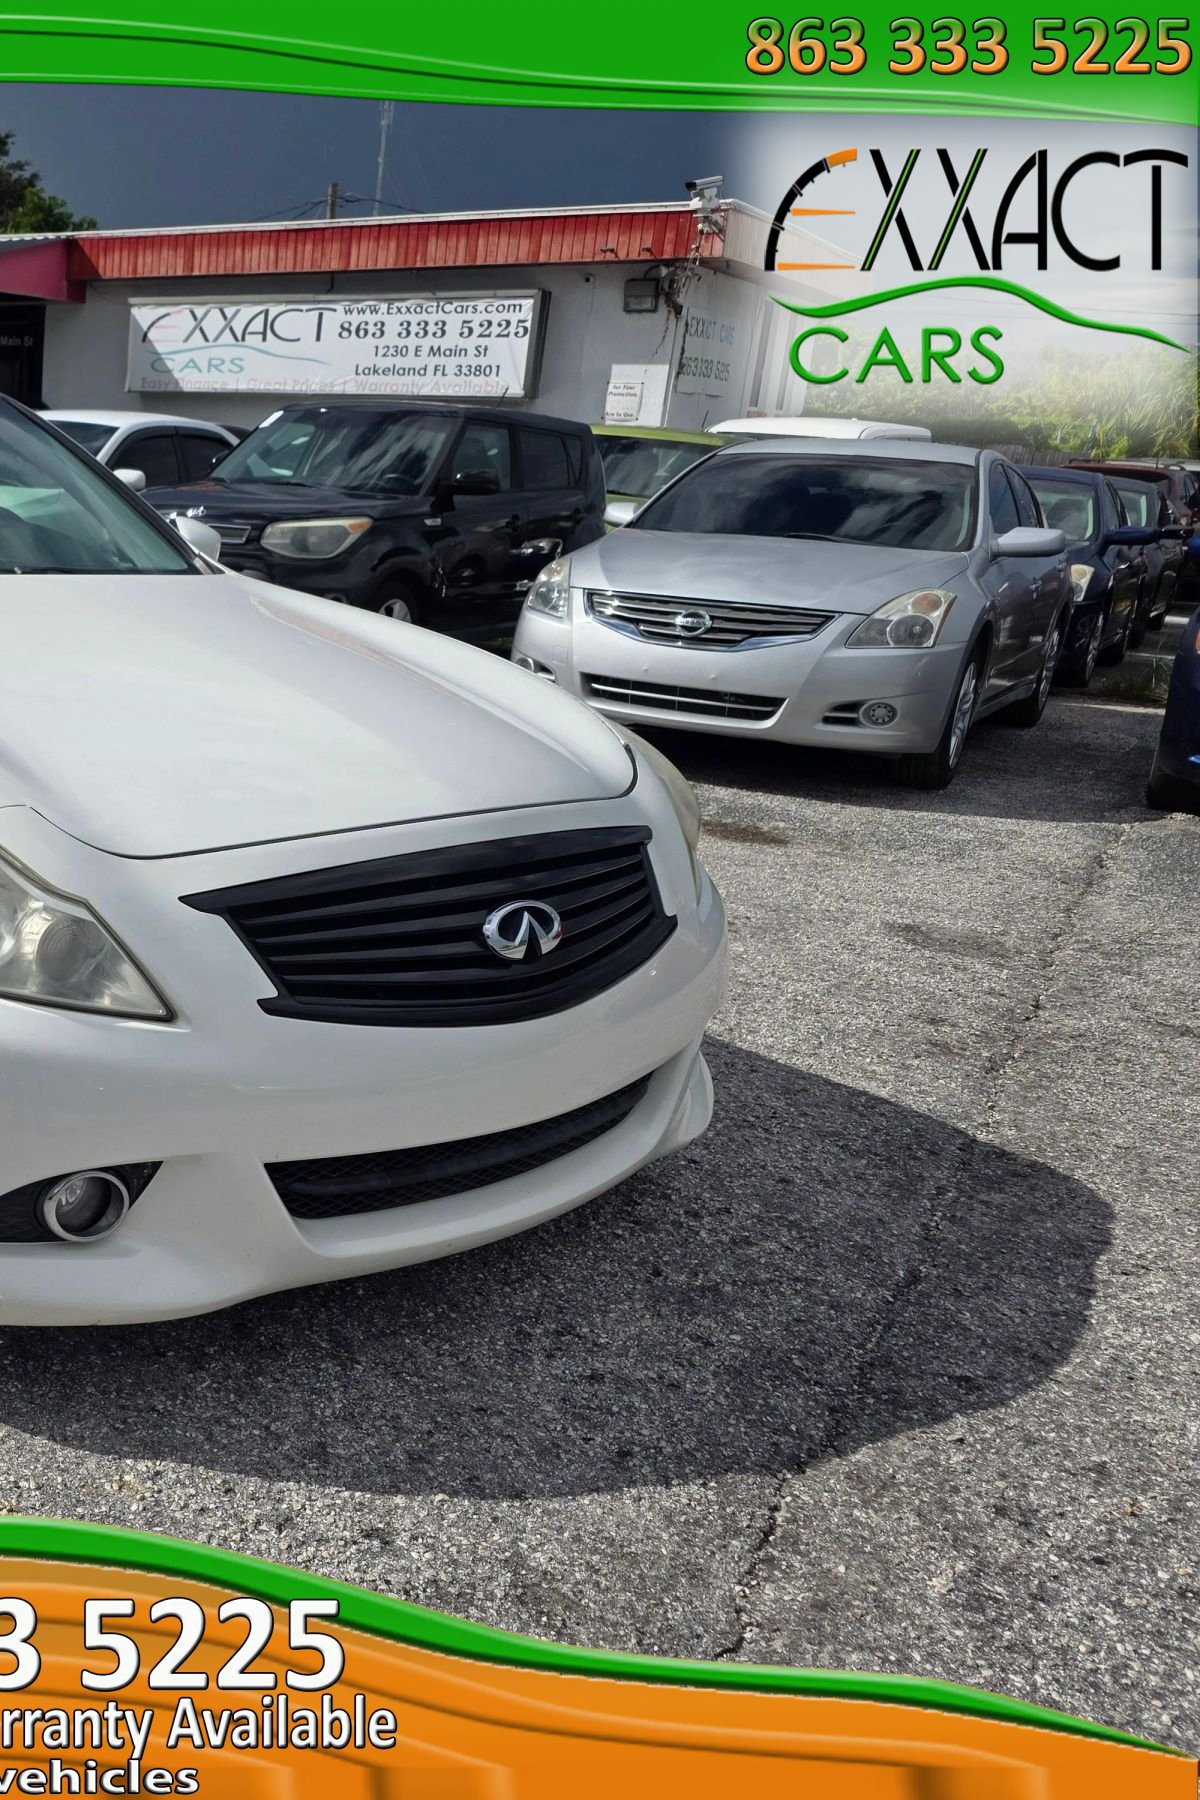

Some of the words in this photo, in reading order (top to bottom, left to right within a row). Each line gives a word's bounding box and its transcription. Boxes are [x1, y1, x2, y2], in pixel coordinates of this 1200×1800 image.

[343, 302, 523, 316] www.ExxactCars.com
[141, 308, 337, 343] EXXACT
[338, 320, 386, 339] 863
[397, 319, 447, 339] 333
[459, 318, 530, 339] 5225
[0, 335, 22, 347] Main
[373, 345, 409, 358] 1230
[414, 345, 423, 357] E
[427, 345, 468, 358] Main
[473, 344, 488, 358] St
[150, 357, 245, 374] CARS
[354, 363, 427, 377] Lakeland
[433, 364, 448, 377] FL
[454, 364, 501, 377] 33801
[140, 377, 174, 391] Easy
[353, 379, 423, 394] Warranty
